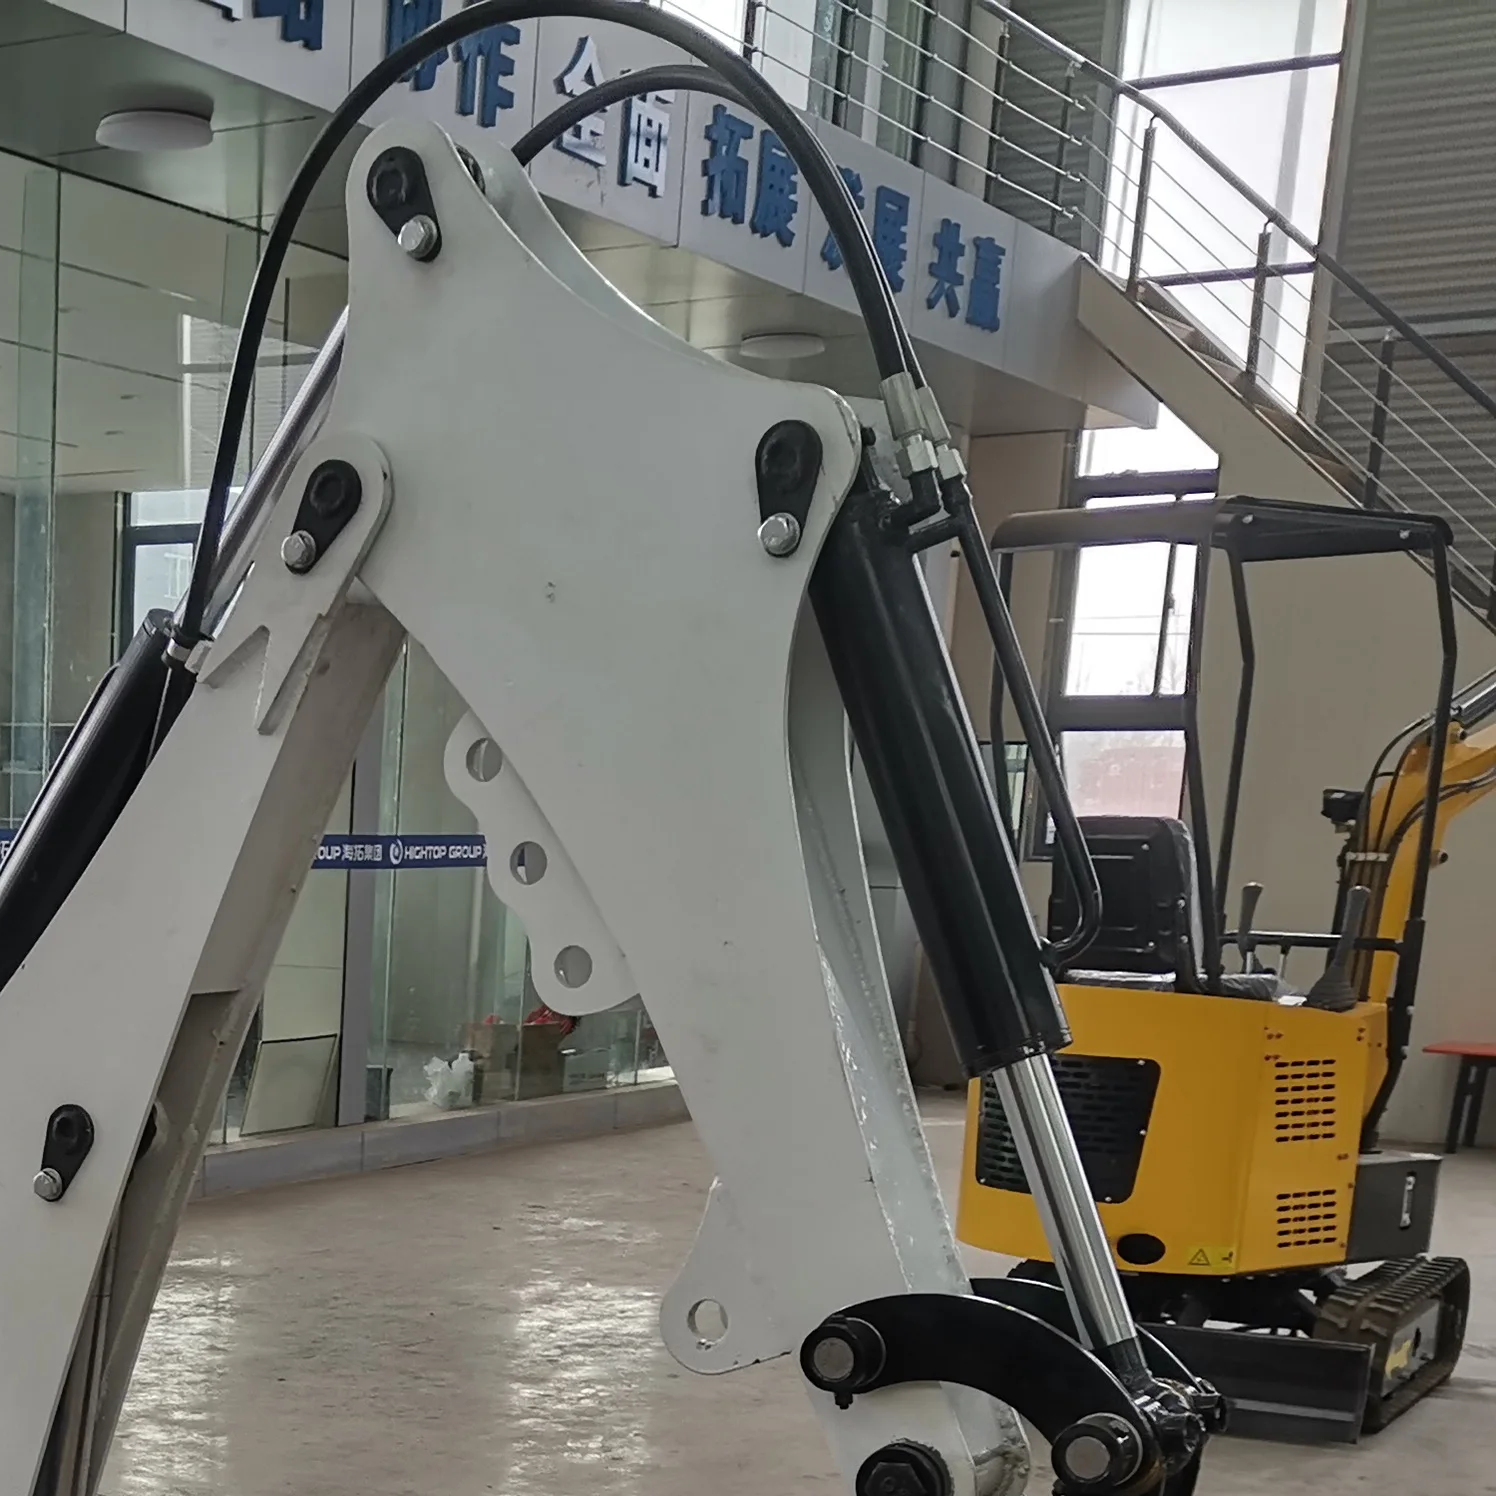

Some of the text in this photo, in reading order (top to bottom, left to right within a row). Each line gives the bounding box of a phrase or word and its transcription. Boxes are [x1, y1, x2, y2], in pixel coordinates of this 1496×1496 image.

[926, 218, 1005, 333] 共赢
[404, 846, 446, 860] HIGHTOP
[448, 845, 481, 859] GROUP
